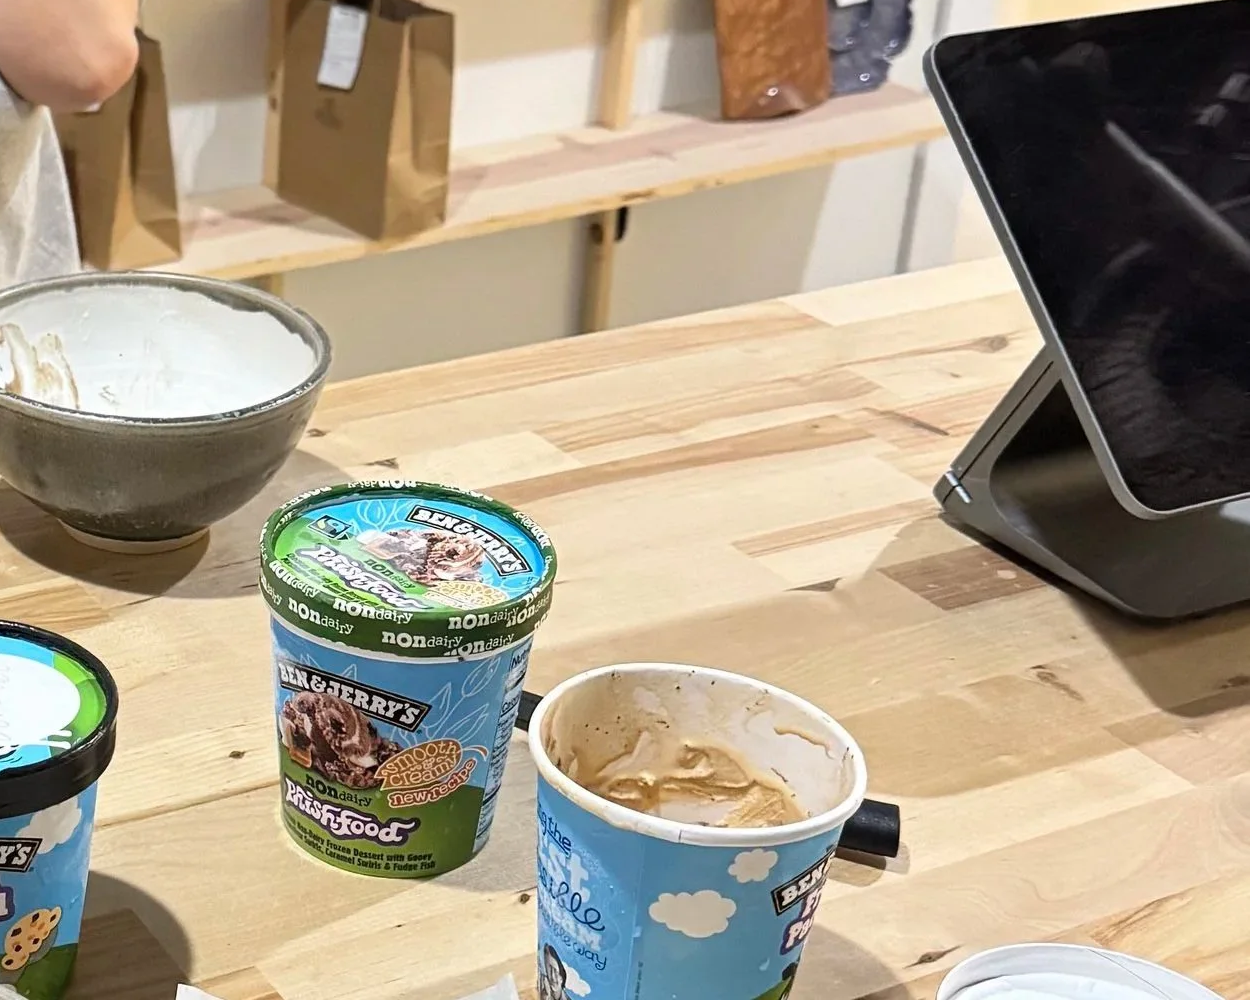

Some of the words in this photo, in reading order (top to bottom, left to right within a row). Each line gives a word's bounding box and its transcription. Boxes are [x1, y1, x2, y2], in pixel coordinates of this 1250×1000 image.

[288, 597, 354, 635] nondairy
[333, 598, 414, 625] nondairy
[382, 631, 463, 650] nondairy
[326, 839, 351, 855] Frozen
[353, 850, 384, 862] Dessert
[386, 851, 405, 862] with
[393, 863, 418, 872] Fudge
